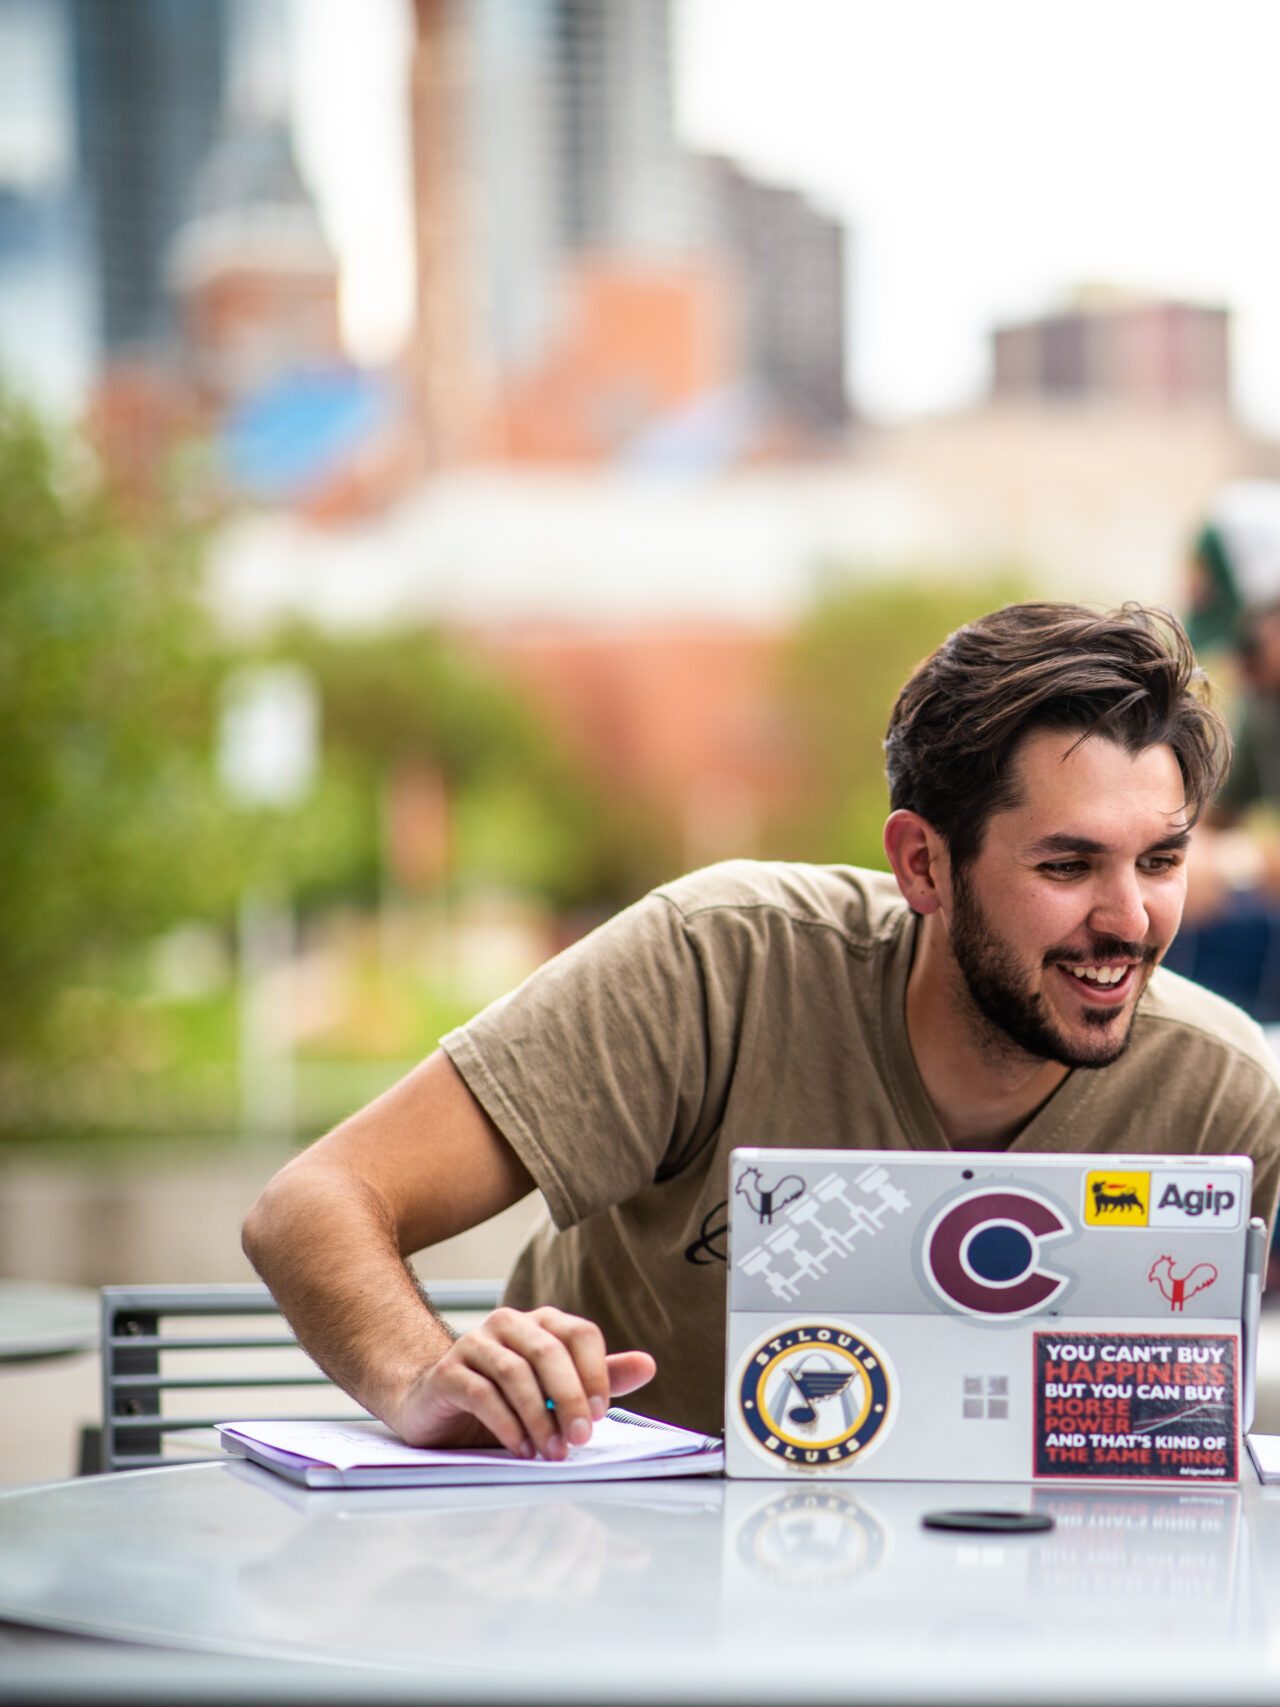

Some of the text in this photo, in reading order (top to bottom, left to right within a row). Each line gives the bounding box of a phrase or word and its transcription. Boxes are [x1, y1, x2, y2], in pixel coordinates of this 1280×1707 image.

[1157, 1183, 1235, 1217] Agip
[797, 1329, 877, 1370] LOUIS
[1046, 1344, 1225, 1364] YOU CAN'T BUY
[1044, 1361, 1226, 1385] HAPPINESS
[1045, 1383, 1226, 1401] BUT YOU CAN BUY
[1044, 1399, 1130, 1416] HORSE
[1044, 1417, 1130, 1434] POWER
[764, 1435, 860, 1463] BLUES
[1045, 1434, 1227, 1451] AND THAT'S KIND OF
[1046, 1448, 1228, 1465] THE SAME THING
